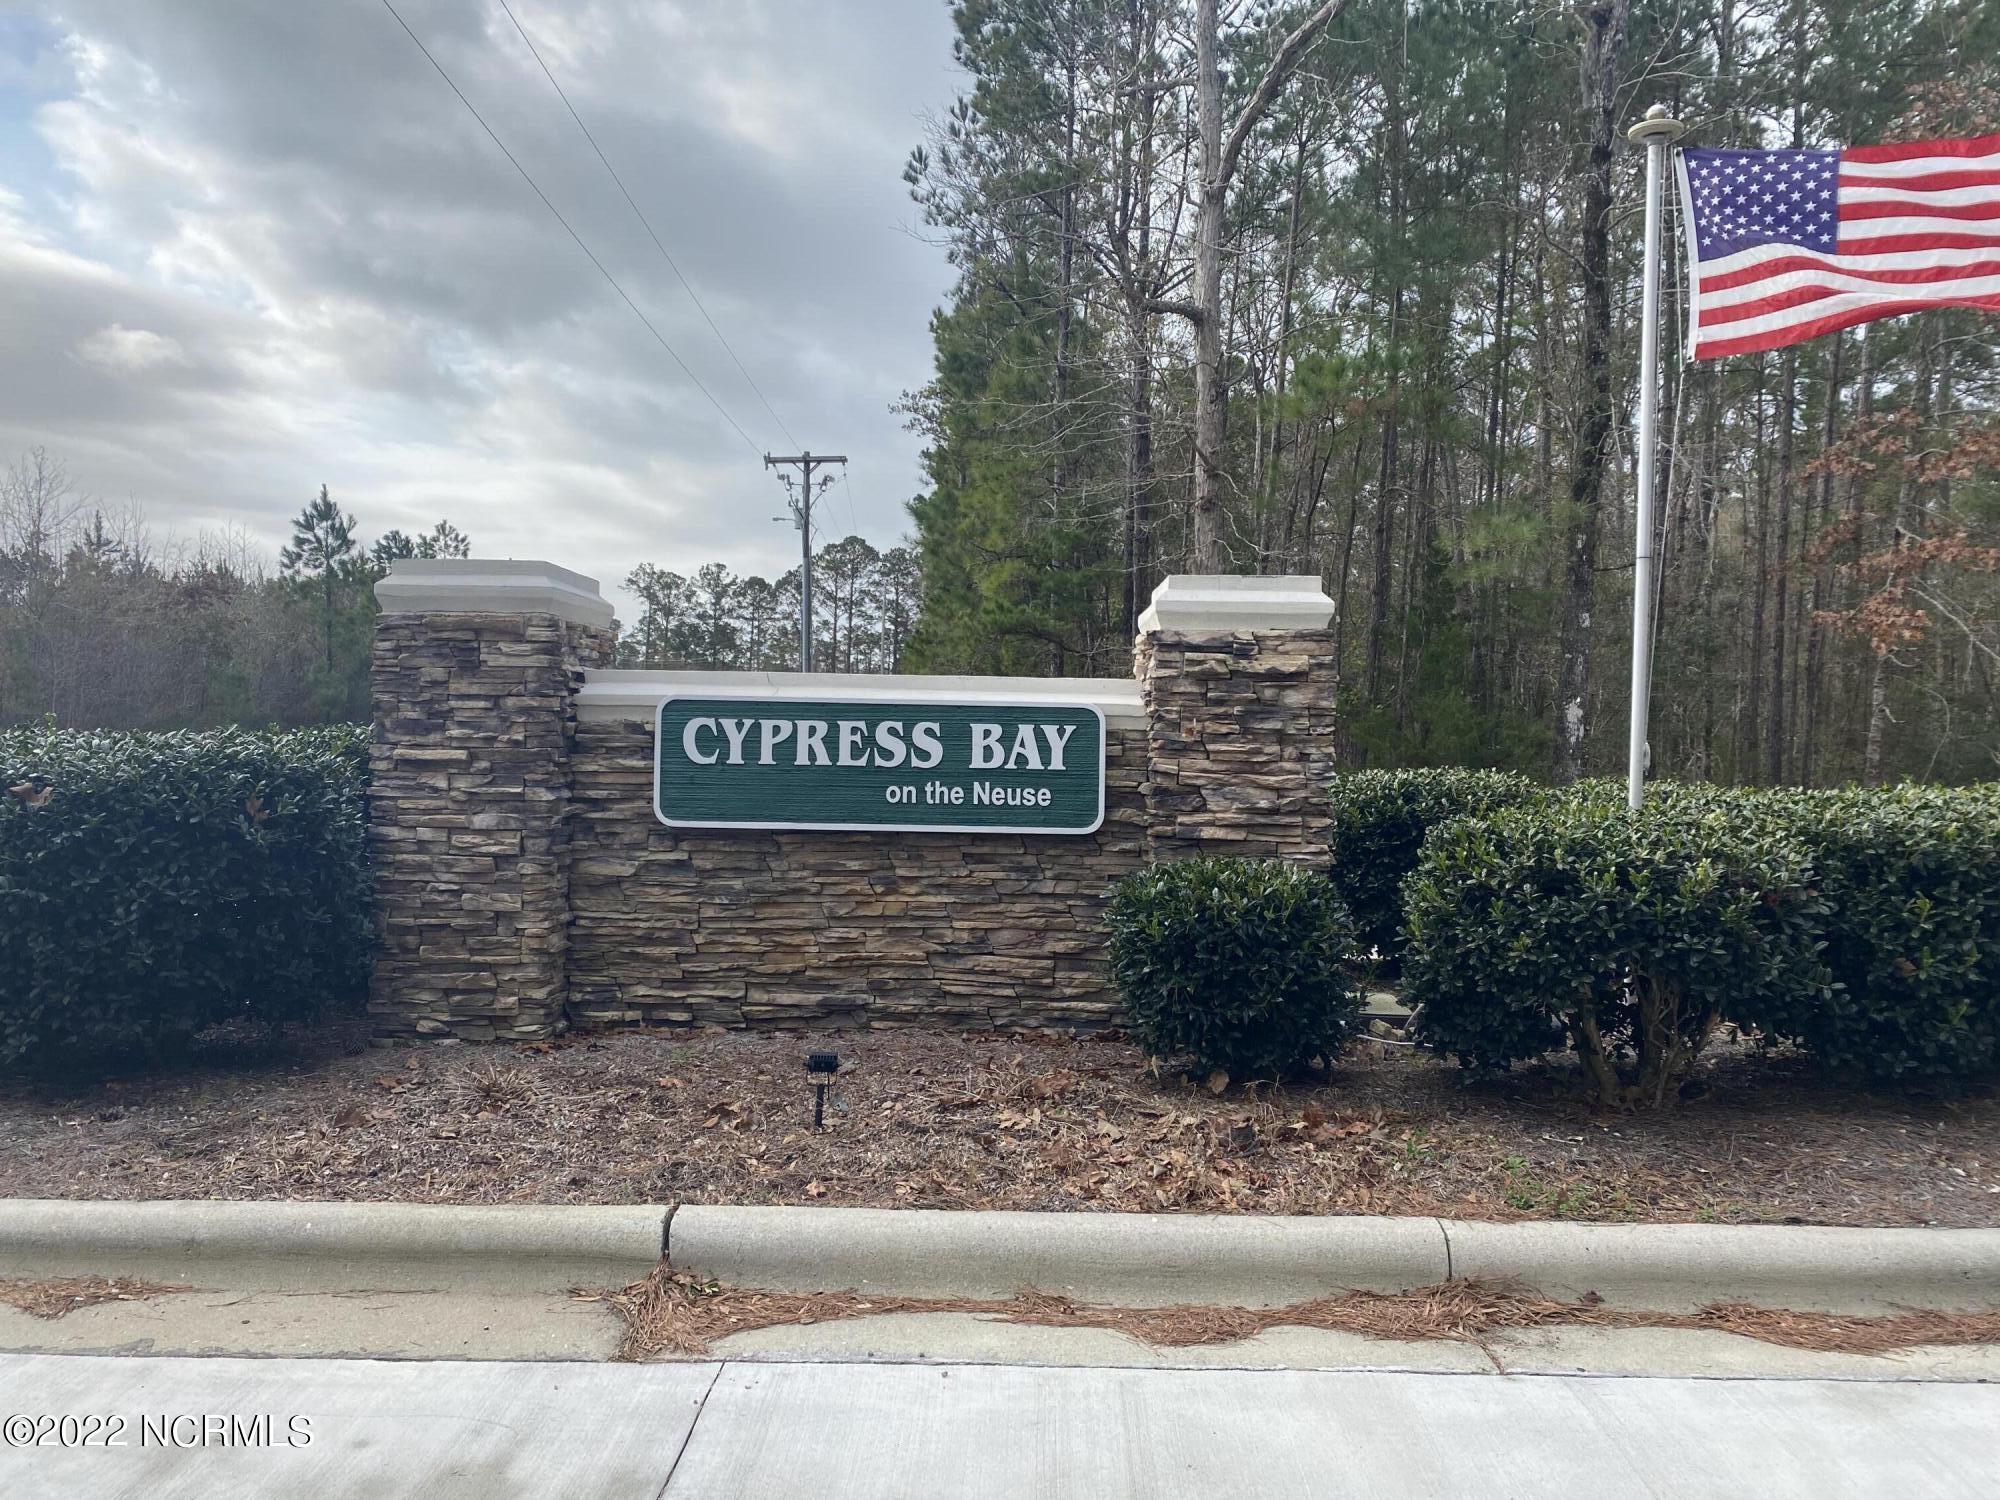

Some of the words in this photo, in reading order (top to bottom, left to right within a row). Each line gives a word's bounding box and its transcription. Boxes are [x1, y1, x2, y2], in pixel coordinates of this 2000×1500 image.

[682, 716, 944, 769] CYPRESS
[968, 723, 1078, 771] BAY
[885, 784, 917, 804] on
[924, 780, 964, 805] the
[973, 781, 1052, 807] Neuse
